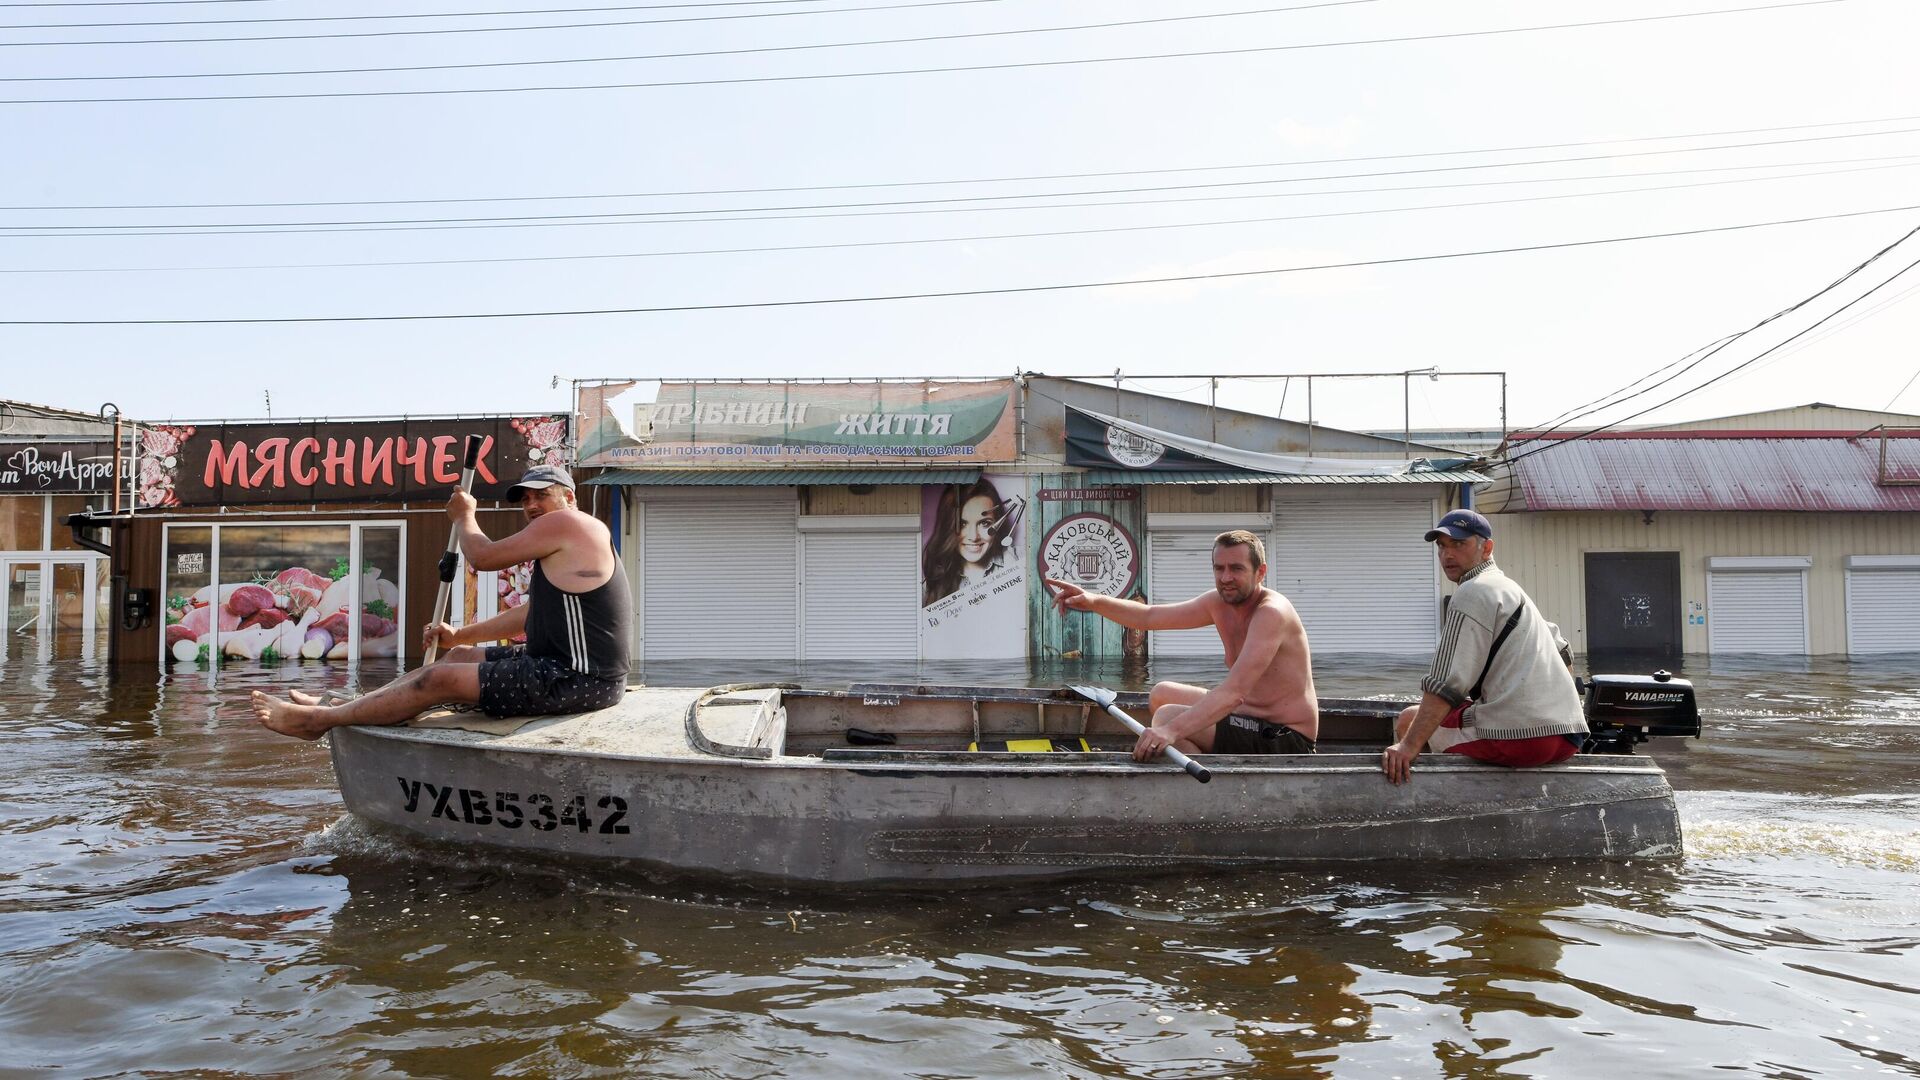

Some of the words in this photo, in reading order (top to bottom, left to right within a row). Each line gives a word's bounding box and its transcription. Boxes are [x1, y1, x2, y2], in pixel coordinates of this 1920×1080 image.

[652, 402, 811, 429] ДРІБНИЦІ
[834, 413, 953, 435] ЖИТТЯ
[204, 434, 498, 489] МЯСНИЧЕК
[611, 446, 672, 457] МАГАЗИН
[674, 445, 747, 456] ПОБУТОВОЇ
[751, 444, 781, 455] ХІМІЇ
[787, 446, 801, 455] ТА
[805, 445, 917, 457] ГОСПОДАРСЬКИХ
[919, 445, 975, 456] ТОВАРІВ
[22, 446, 60, 475] Bon
[58, 450, 140, 490] Appeit
[1050, 490, 1068, 500] ЦІНИ
[1071, 490, 1083, 500] ВІД
[1048, 522, 1130, 562] КАХОВСЬКИЙ
[992, 575, 1023, 595] PANTENE
[1625, 691, 1684, 702] YAMARINE
